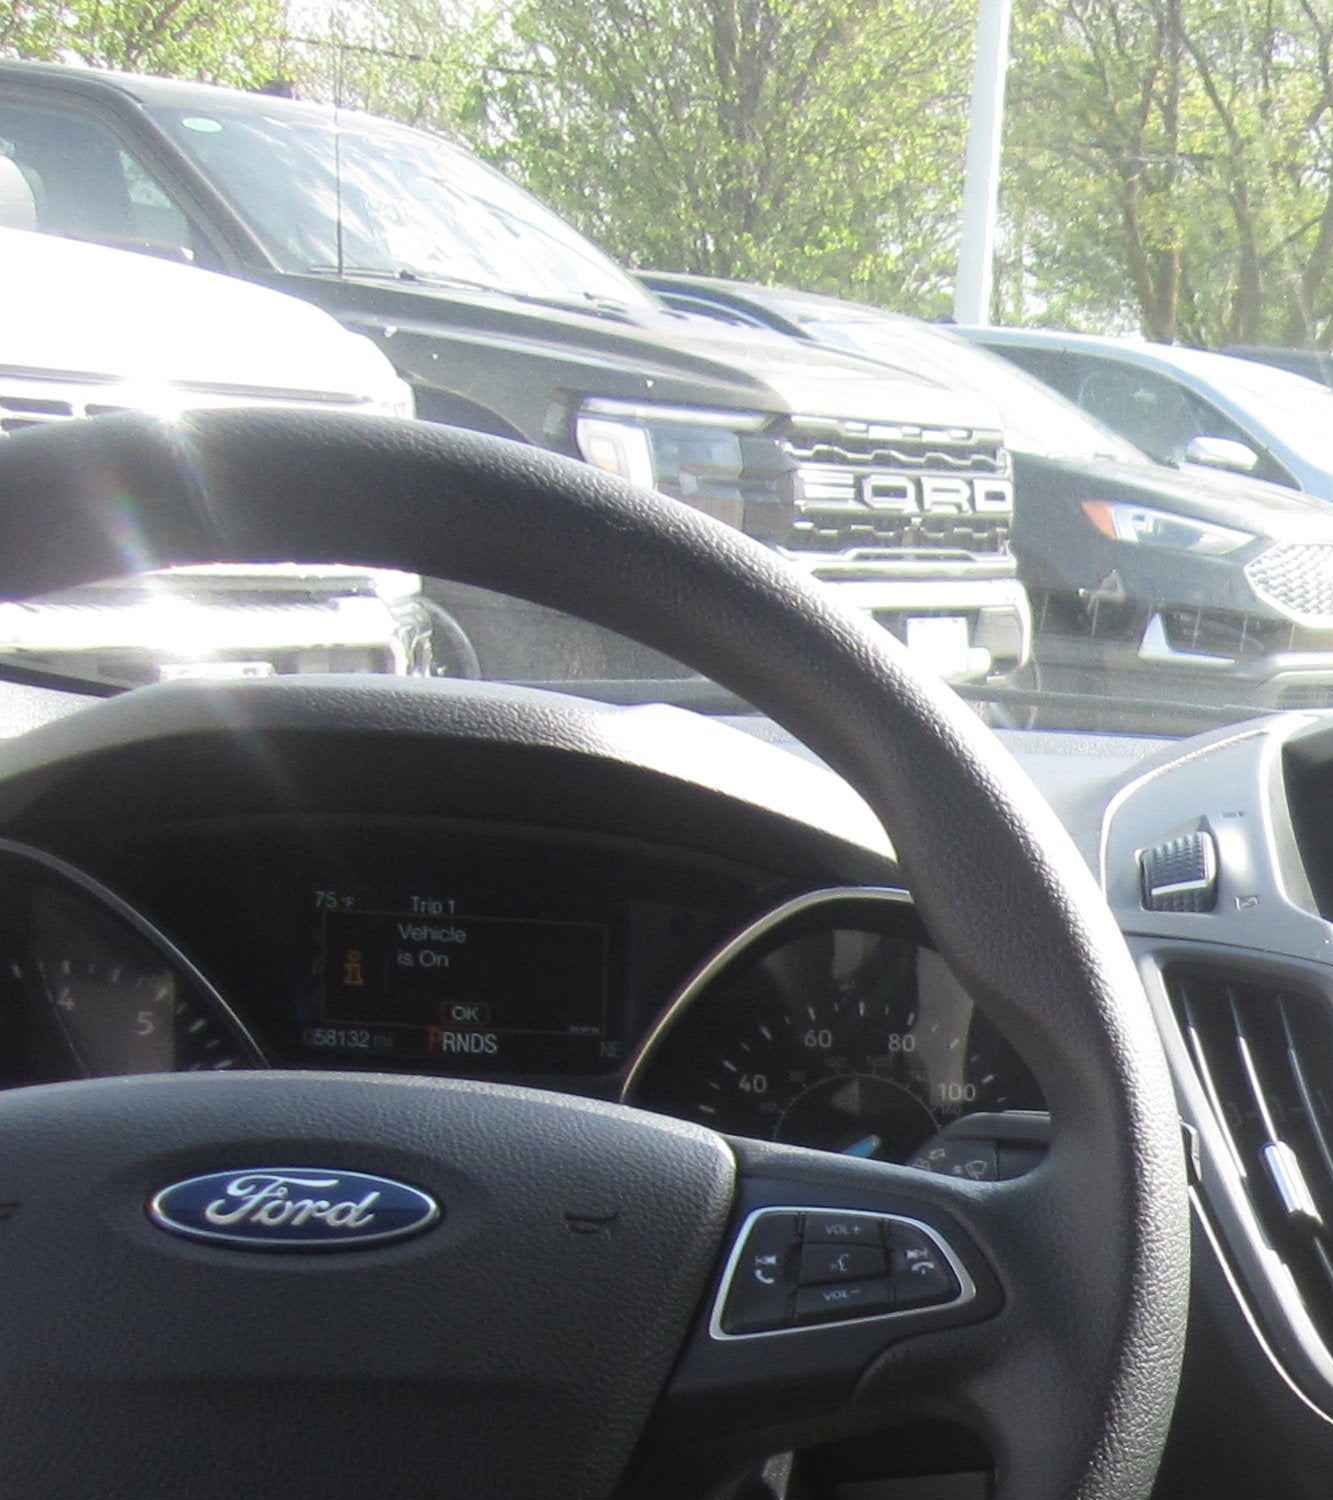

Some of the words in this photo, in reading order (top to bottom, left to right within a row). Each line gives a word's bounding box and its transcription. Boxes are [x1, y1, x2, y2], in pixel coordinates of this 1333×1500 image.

[410, 895, 442, 916] Trip
[398, 923, 467, 944] Vehicle
[419, 949, 450, 969] On
[137, 1011, 154, 1037] 5
[451, 1004, 480, 1023] OK
[803, 1028, 833, 1050] 60
[886, 1032, 916, 1054] 80
[738, 1073, 768, 1095] 40
[936, 1082, 978, 1104] 100
[205, 1174, 381, 1228] Ford
